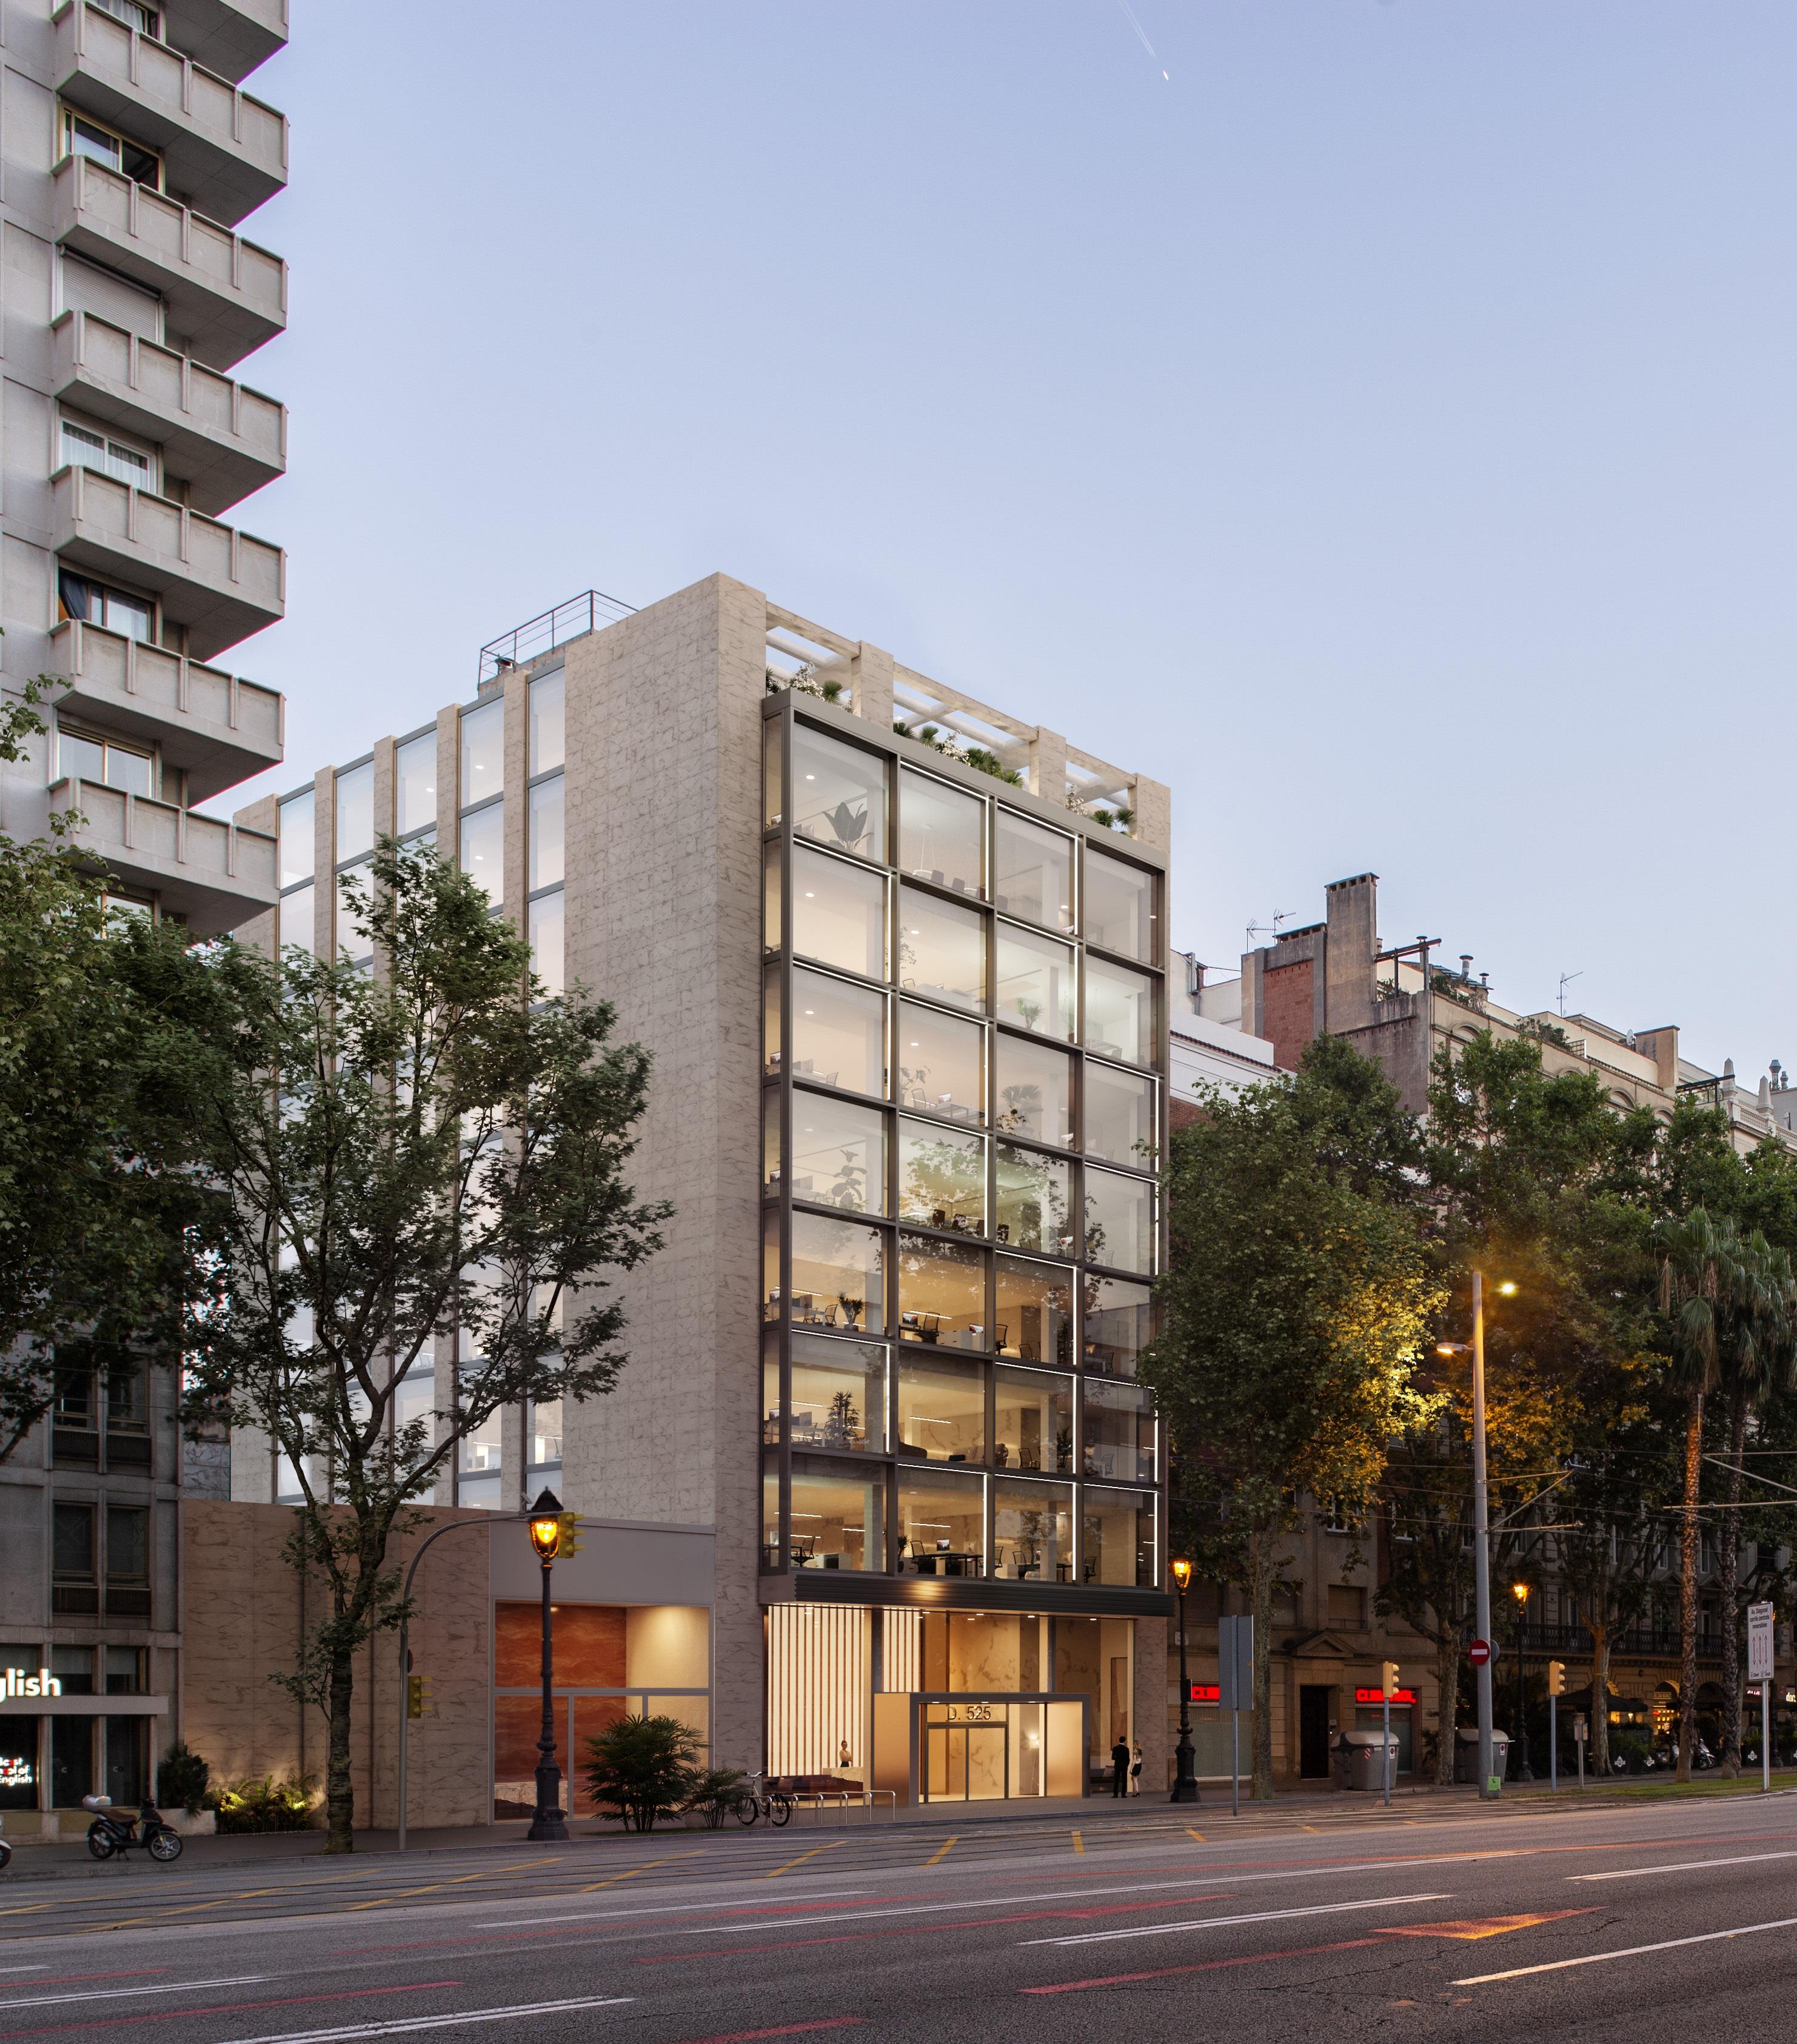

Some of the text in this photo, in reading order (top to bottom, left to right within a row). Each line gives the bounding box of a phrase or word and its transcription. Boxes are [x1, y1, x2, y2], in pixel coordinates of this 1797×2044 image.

[948, 1706, 991, 1720] D. 525
[18, 1765, 30, 1775] of
